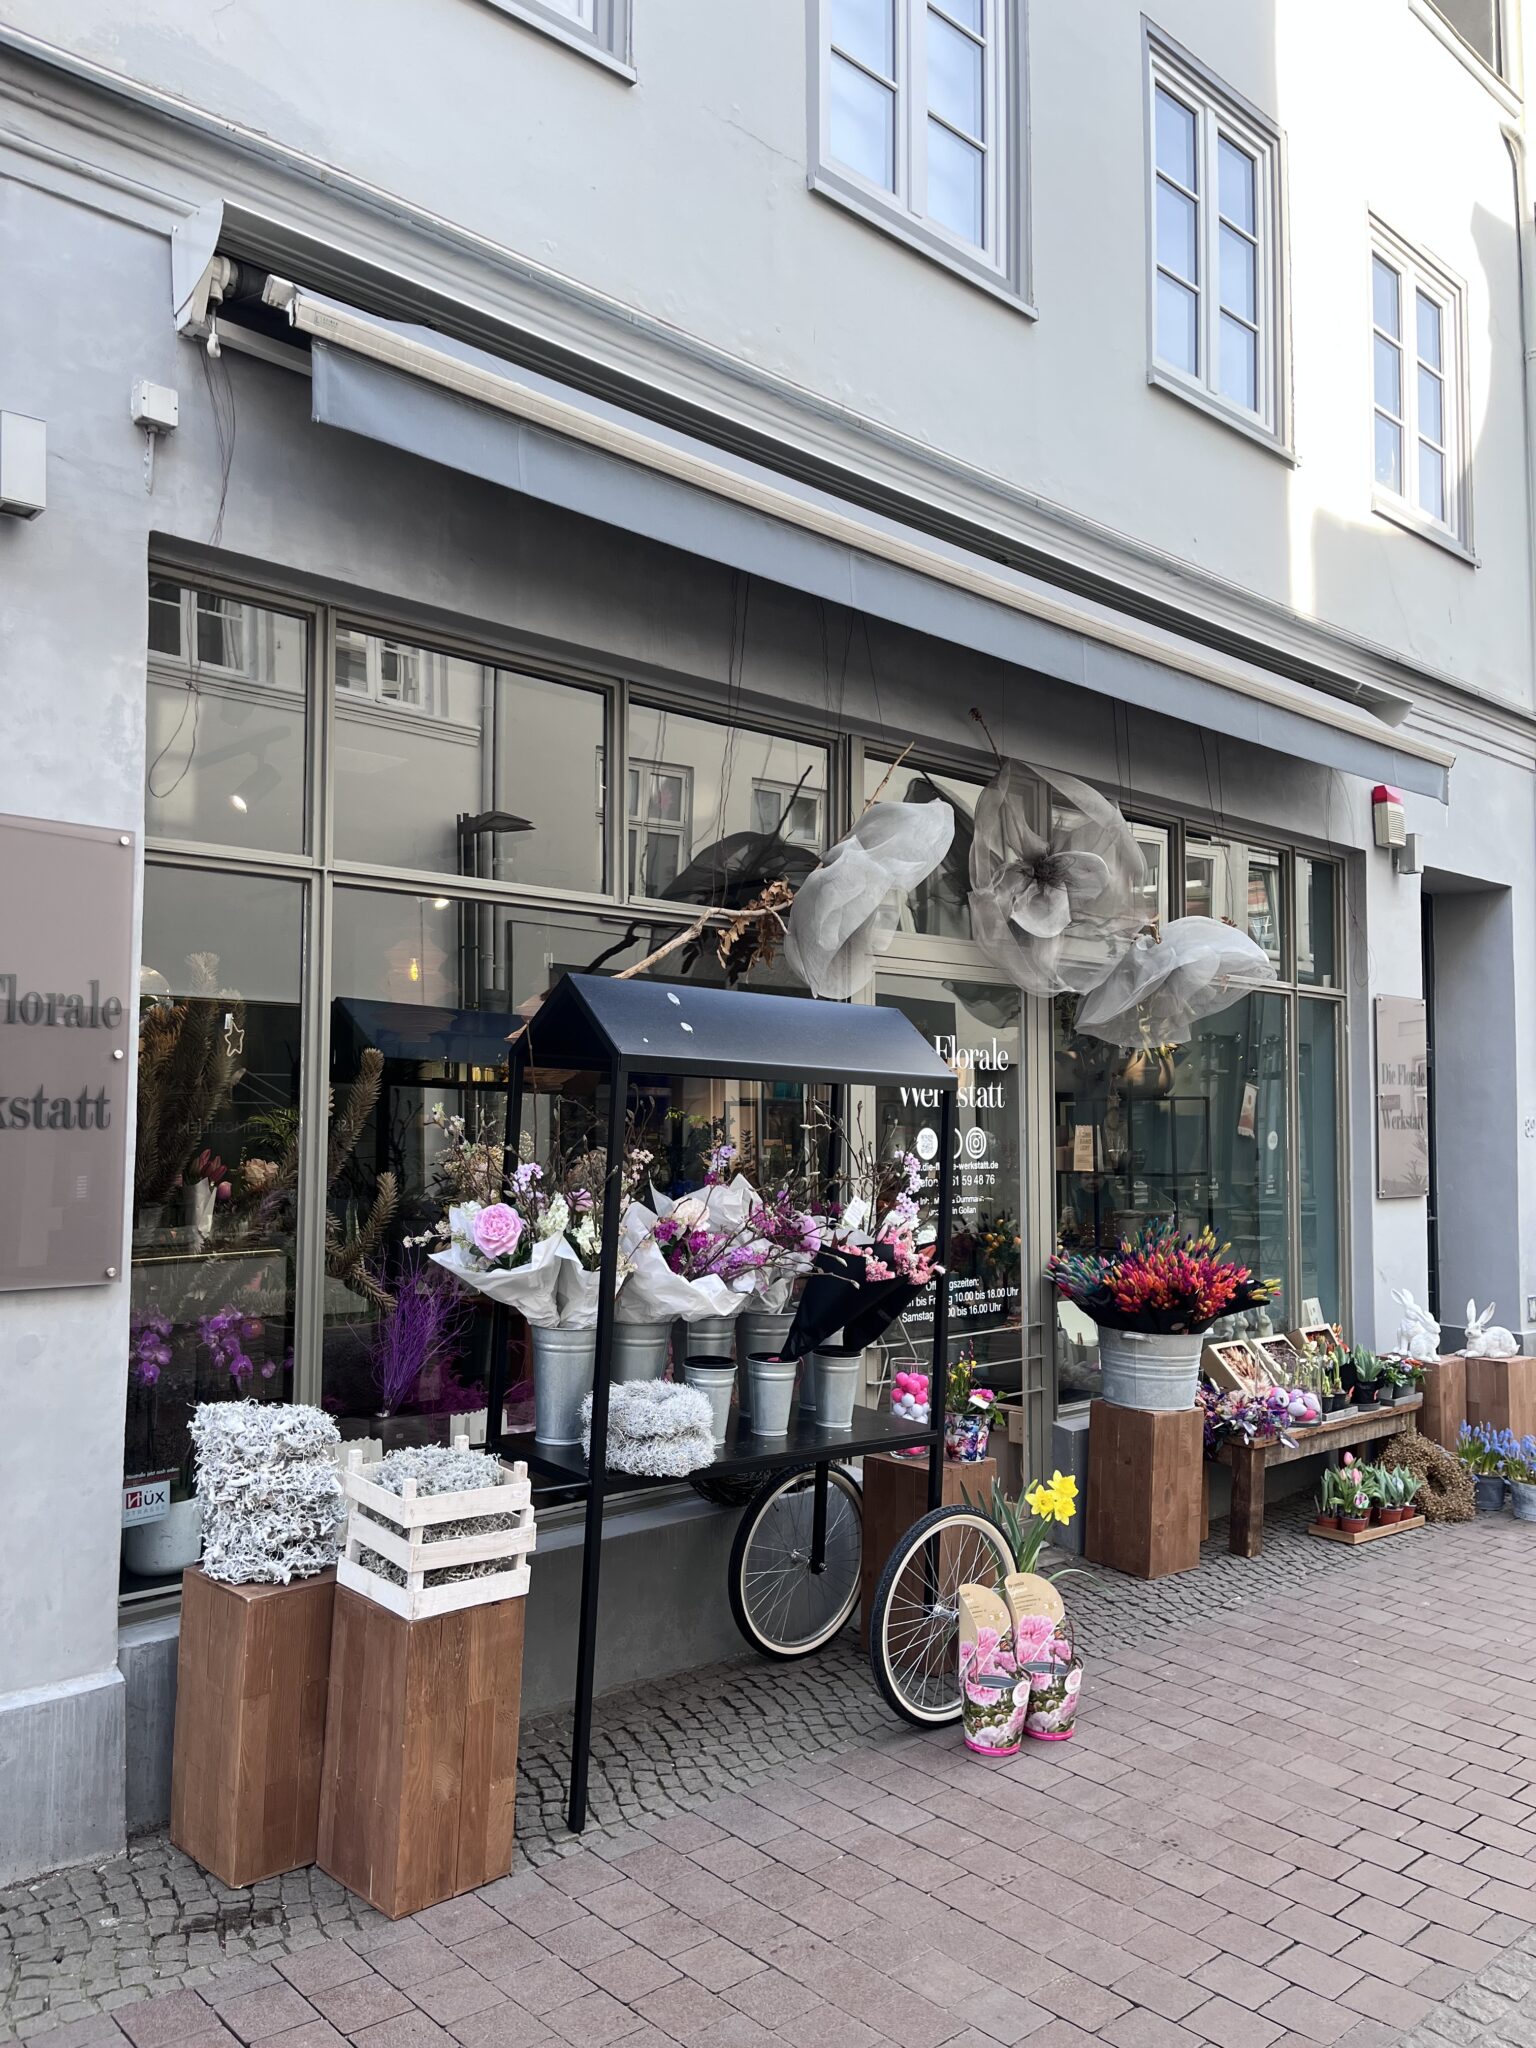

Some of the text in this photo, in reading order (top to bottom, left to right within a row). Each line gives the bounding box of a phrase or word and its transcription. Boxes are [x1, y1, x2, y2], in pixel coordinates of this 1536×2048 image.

[0, 974, 122, 1029] lorale
[934, 1035, 1009, 1071] Florale
[1381, 1063, 1425, 1087] Die Florale
[900, 1082, 1006, 1108] Werstatt
[961, 1175, 972, 1186] 59
[973, 1175, 983, 1186] 48
[985, 1174, 995, 1185] 76
[916, 1296, 927, 1307] bis
[955, 1291, 974, 1302] 10.00
[975, 1290, 985, 1300] bis
[987, 1288, 1005, 1299] 18.00
[1007, 1286, 1019, 1297] Uhr
[901, 1311, 934, 1323] Samstag
[957, 1306, 967, 1317] bis
[969, 1304, 987, 1315] 16.00
[989, 1302, 1001, 1313] Uhr
